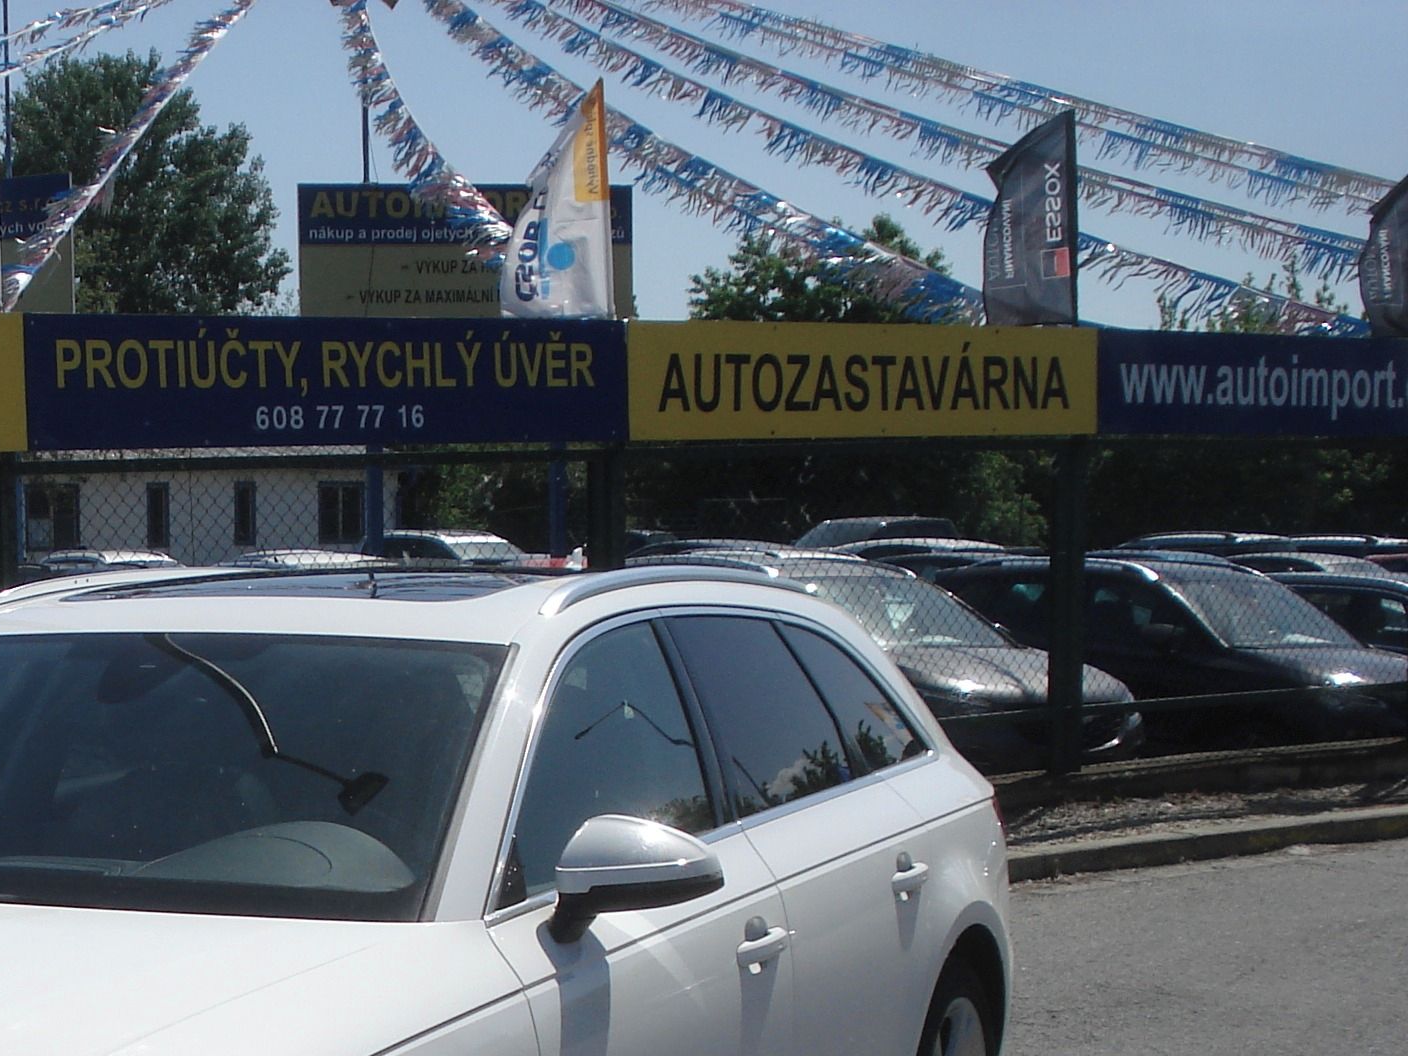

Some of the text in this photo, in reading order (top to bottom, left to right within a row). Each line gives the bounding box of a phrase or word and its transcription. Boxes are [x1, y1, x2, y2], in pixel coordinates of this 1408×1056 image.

[309, 226, 353, 242] nákup
[358, 229, 367, 240] a
[372, 226, 417, 242] prodej
[404, 289, 422, 305] ZA
[55, 328, 596, 397] PROTIÚČTY, RYCHLÝ ÚVĚR
[658, 336, 1070, 413] AUTOZASTAVÁRNA
[255, 404, 424, 430] 608 77 77 16
